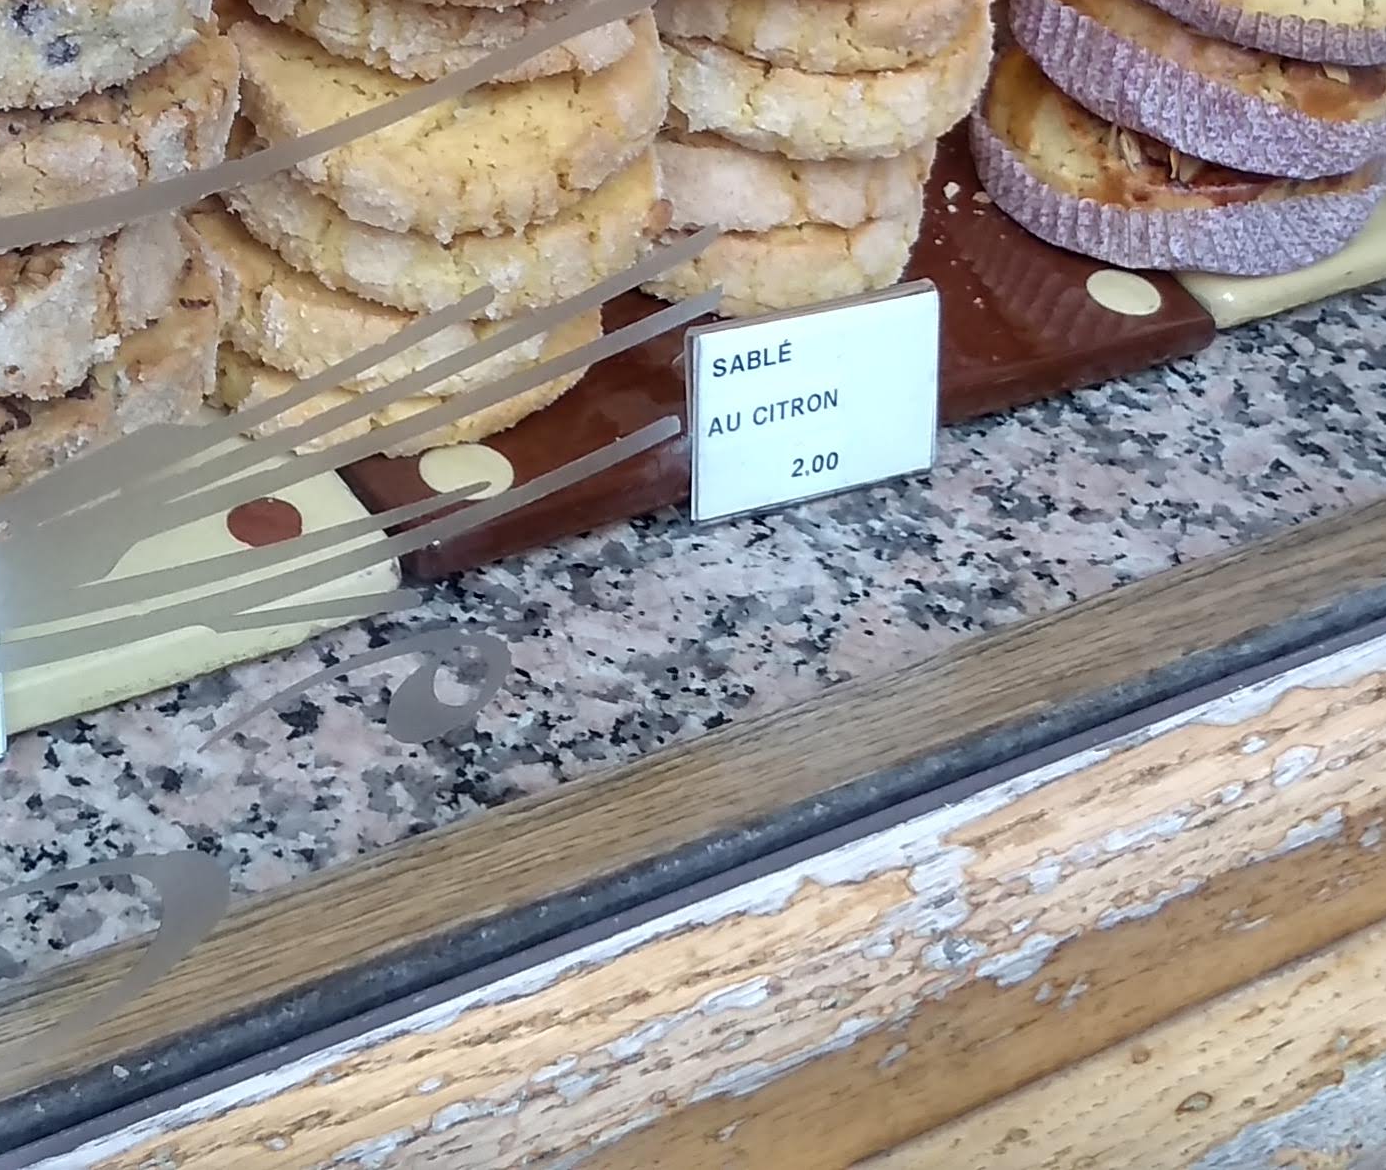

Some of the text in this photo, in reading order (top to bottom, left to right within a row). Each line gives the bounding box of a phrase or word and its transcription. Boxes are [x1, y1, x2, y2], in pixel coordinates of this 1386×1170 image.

[712, 339, 792, 378] SABLÉ
[708, 388, 838, 438] AU CITRON
